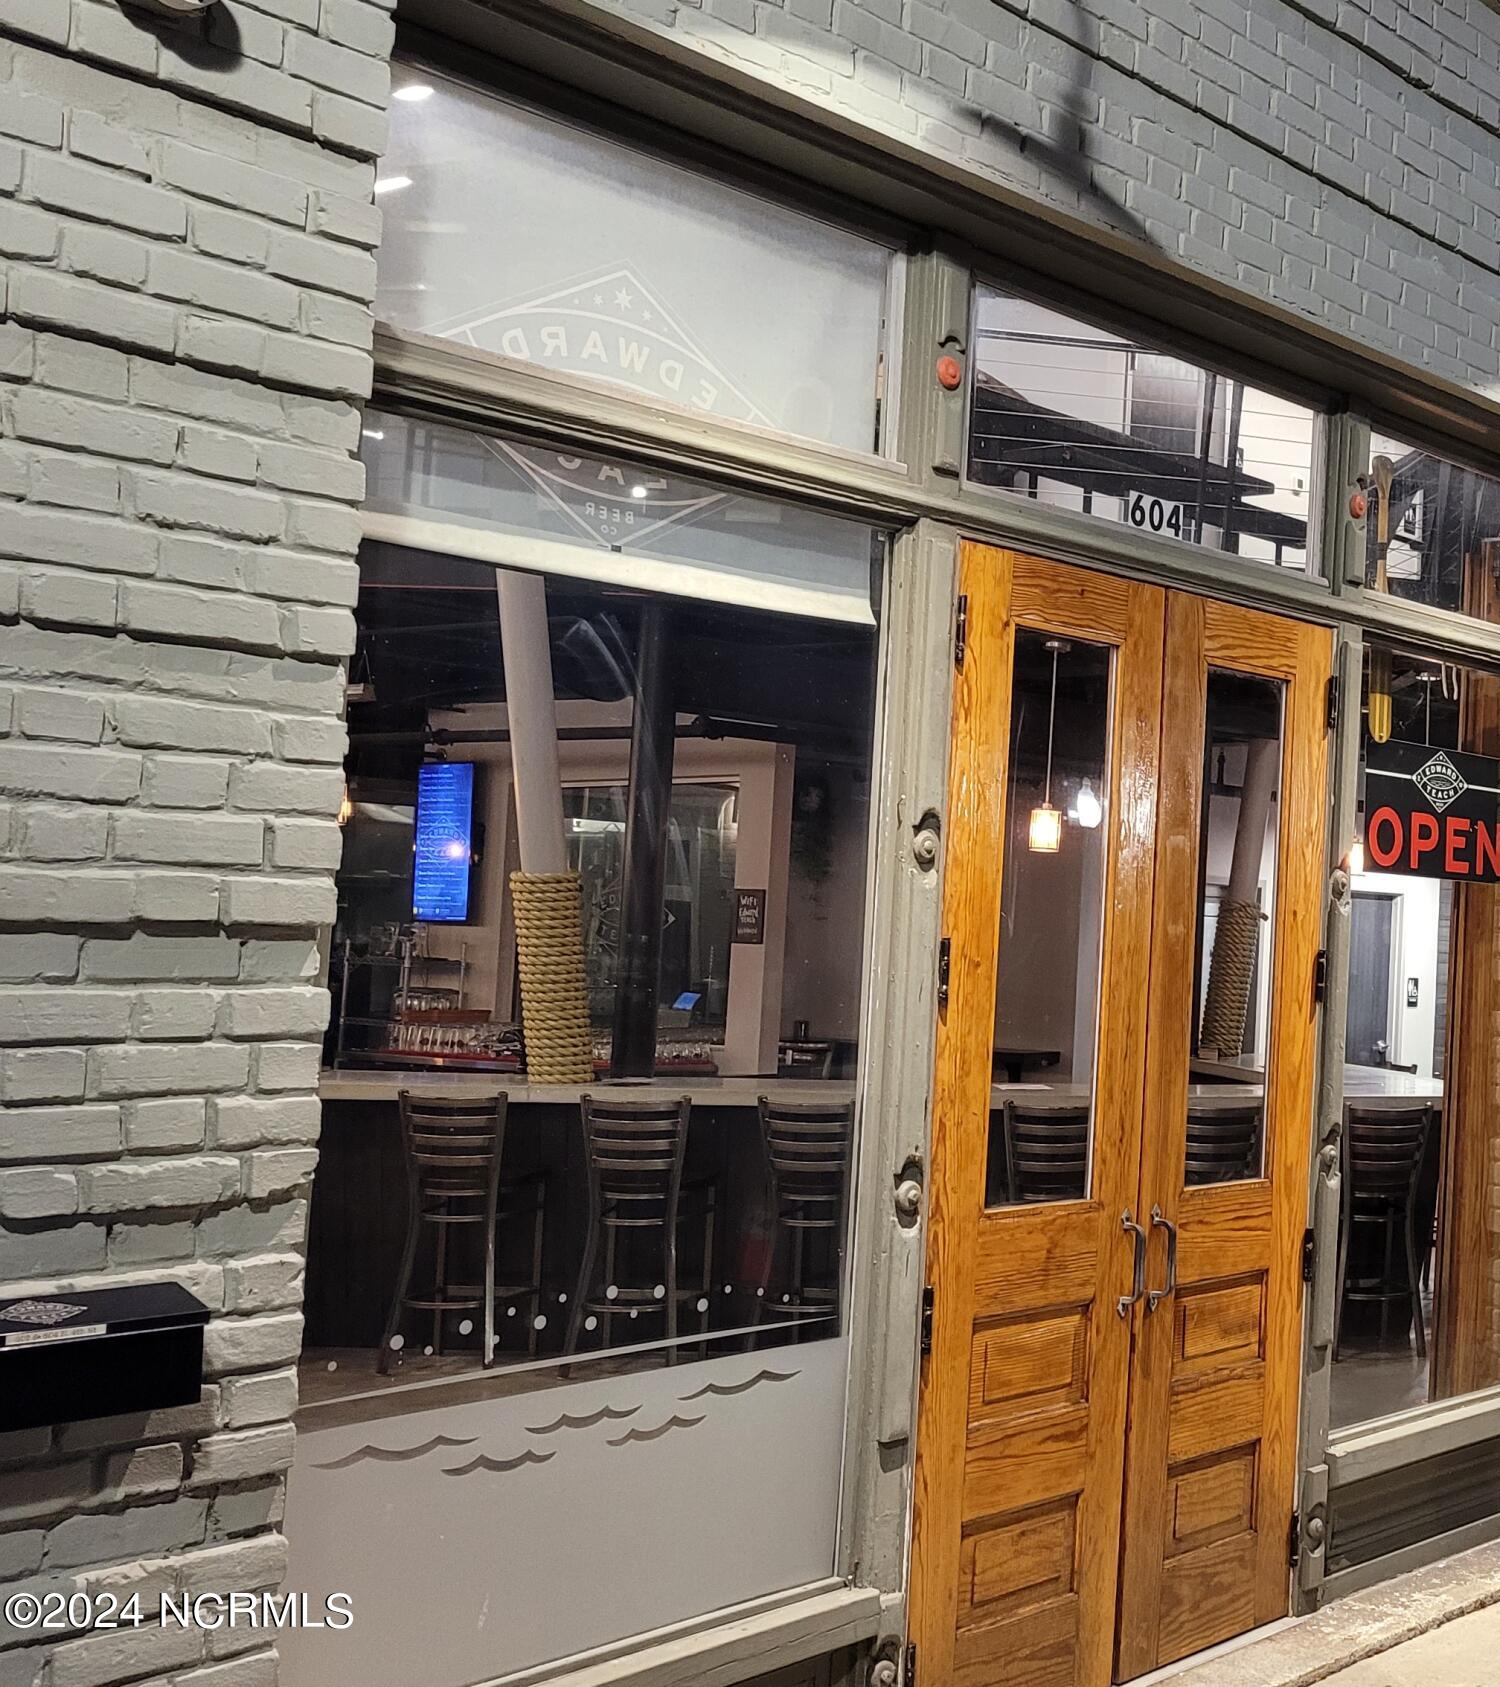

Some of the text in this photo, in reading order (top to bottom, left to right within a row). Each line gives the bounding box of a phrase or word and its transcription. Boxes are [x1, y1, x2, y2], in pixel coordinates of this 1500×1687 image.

[1130, 493, 1181, 538] 604
[1425, 764, 1457, 780] EDWARD
[1426, 785, 1455, 799] TEACH
